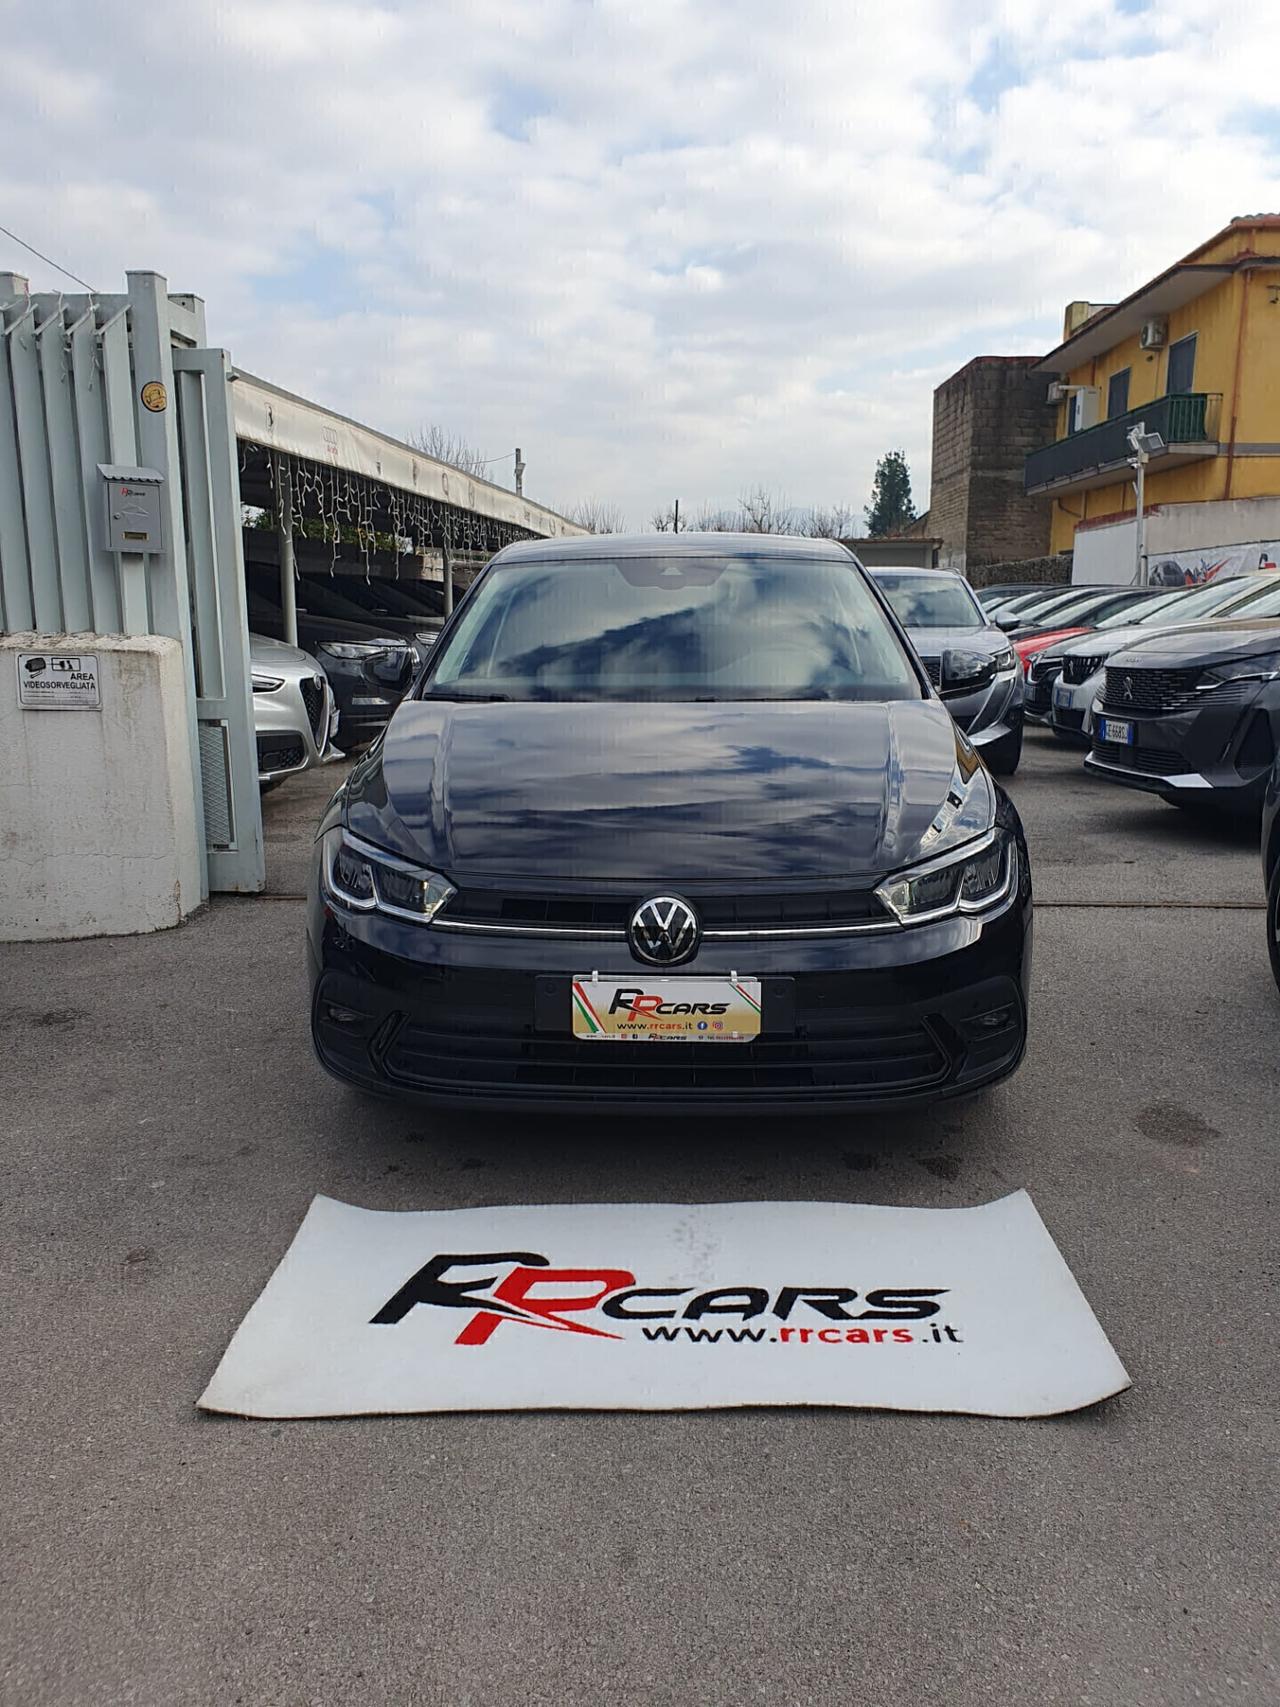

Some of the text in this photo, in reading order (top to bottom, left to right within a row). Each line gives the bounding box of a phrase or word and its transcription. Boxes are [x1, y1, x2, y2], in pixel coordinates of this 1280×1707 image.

[70, 673, 94, 681] AREA
[23, 681, 96, 691] VIDEOSORVEGLIATA
[617, 1021, 693, 1030] www.rrcars.it
[640, 1322, 965, 1345] www.rrcars.it
